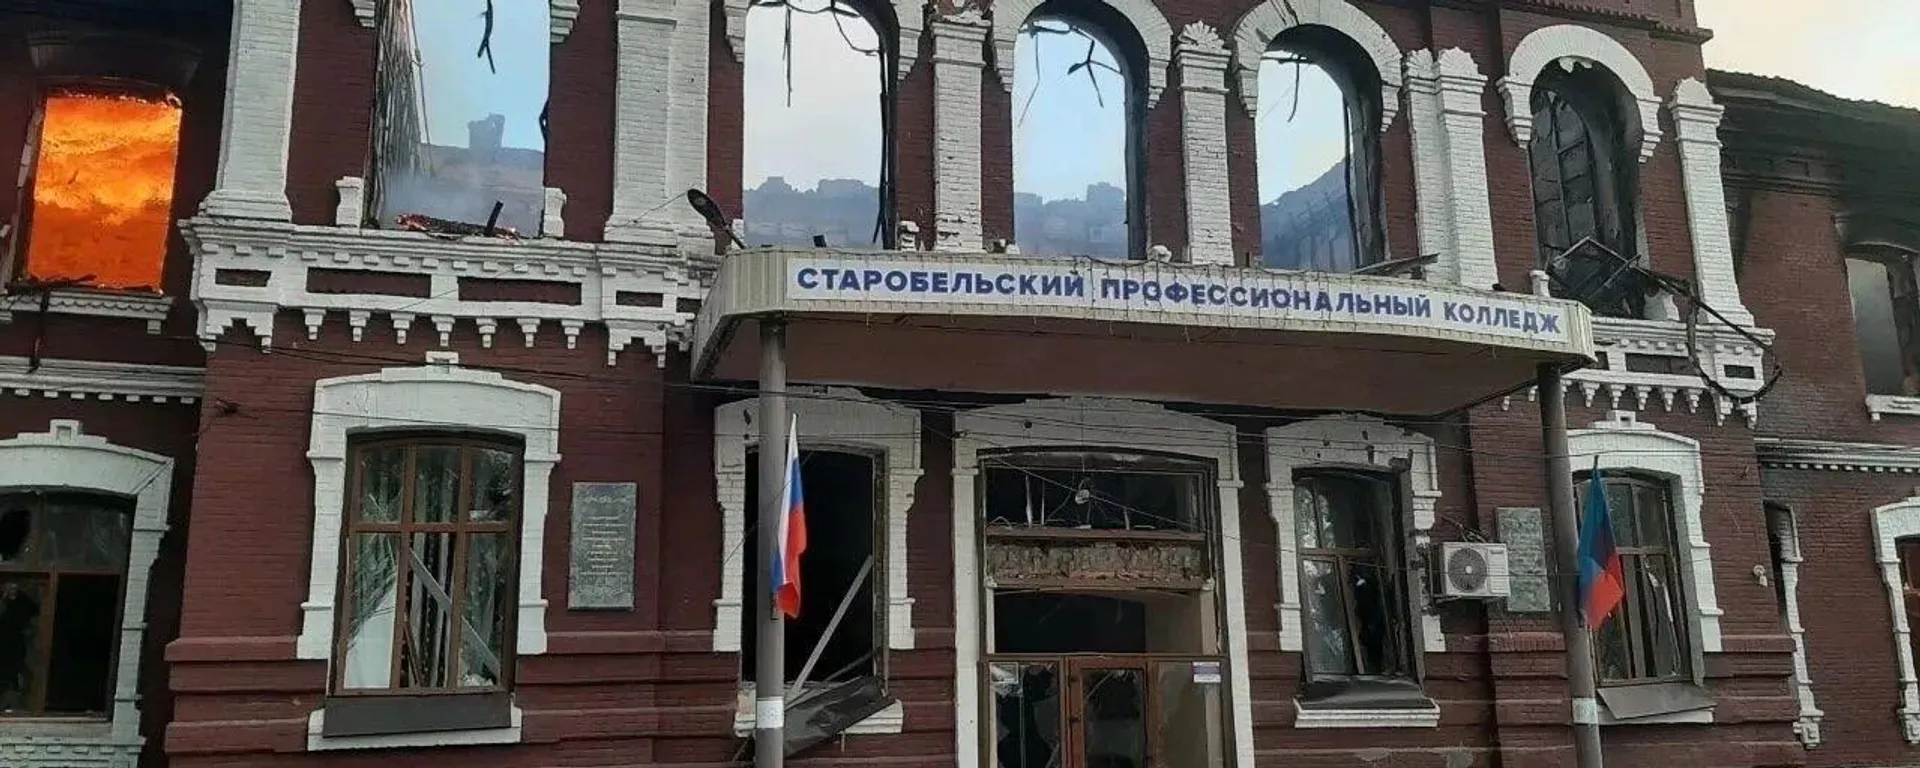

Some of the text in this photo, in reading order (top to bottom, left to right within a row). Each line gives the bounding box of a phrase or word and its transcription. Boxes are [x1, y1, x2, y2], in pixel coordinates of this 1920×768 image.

[797, 268, 1560, 334] СТАРОБЕЛЬСКИЙ ПРОФЕССИОНАЛЬНЫЙ КОЛЛЕДЖ
